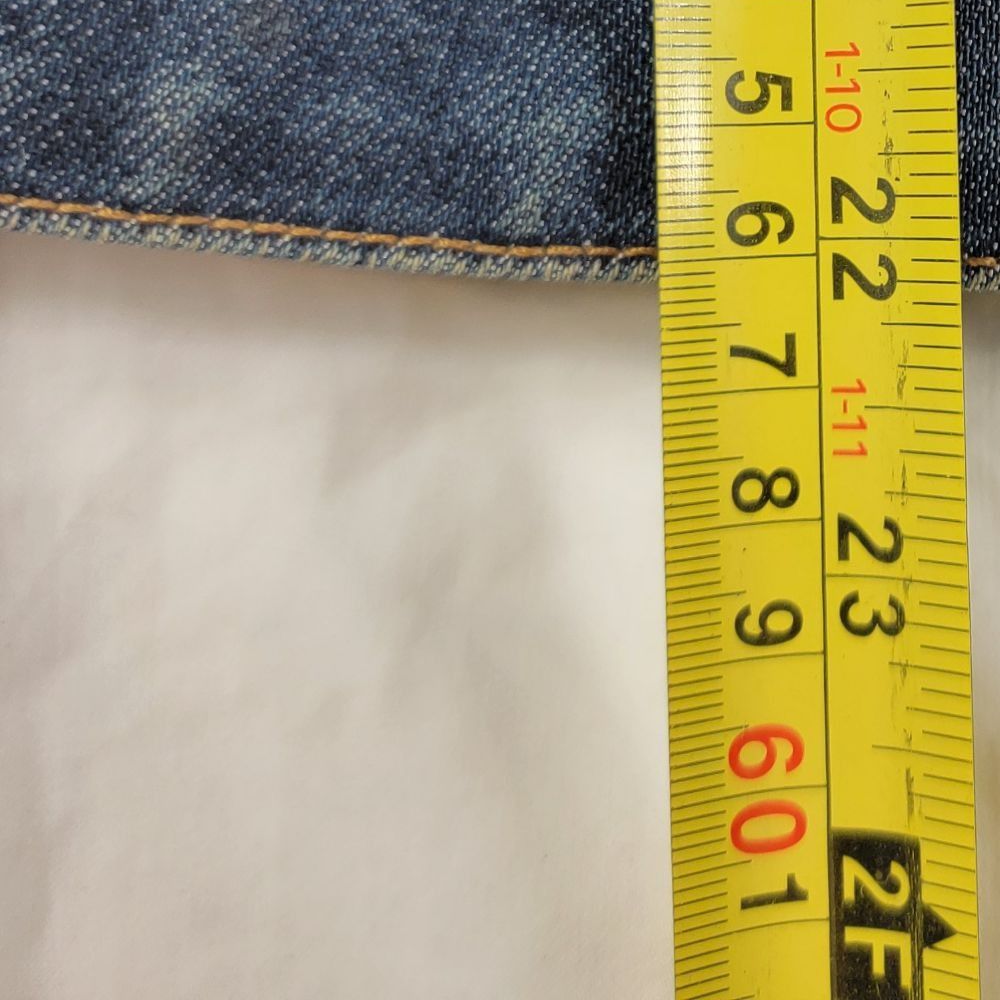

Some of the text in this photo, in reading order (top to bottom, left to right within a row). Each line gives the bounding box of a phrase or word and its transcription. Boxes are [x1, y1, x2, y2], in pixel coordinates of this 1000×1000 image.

[725, 70, 793, 114] 5
[825, 42, 862, 133] 1-10
[726, 201, 795, 247] 6
[830, 176, 898, 301] 22
[729, 332, 797, 378] 7
[831, 378, 868, 456] 1-11
[731, 466, 800, 513] 8
[837, 512, 906, 637] 23
[734, 598, 803, 647] 9
[728, 723, 807, 854] 60
[740, 872, 809, 911] 1
